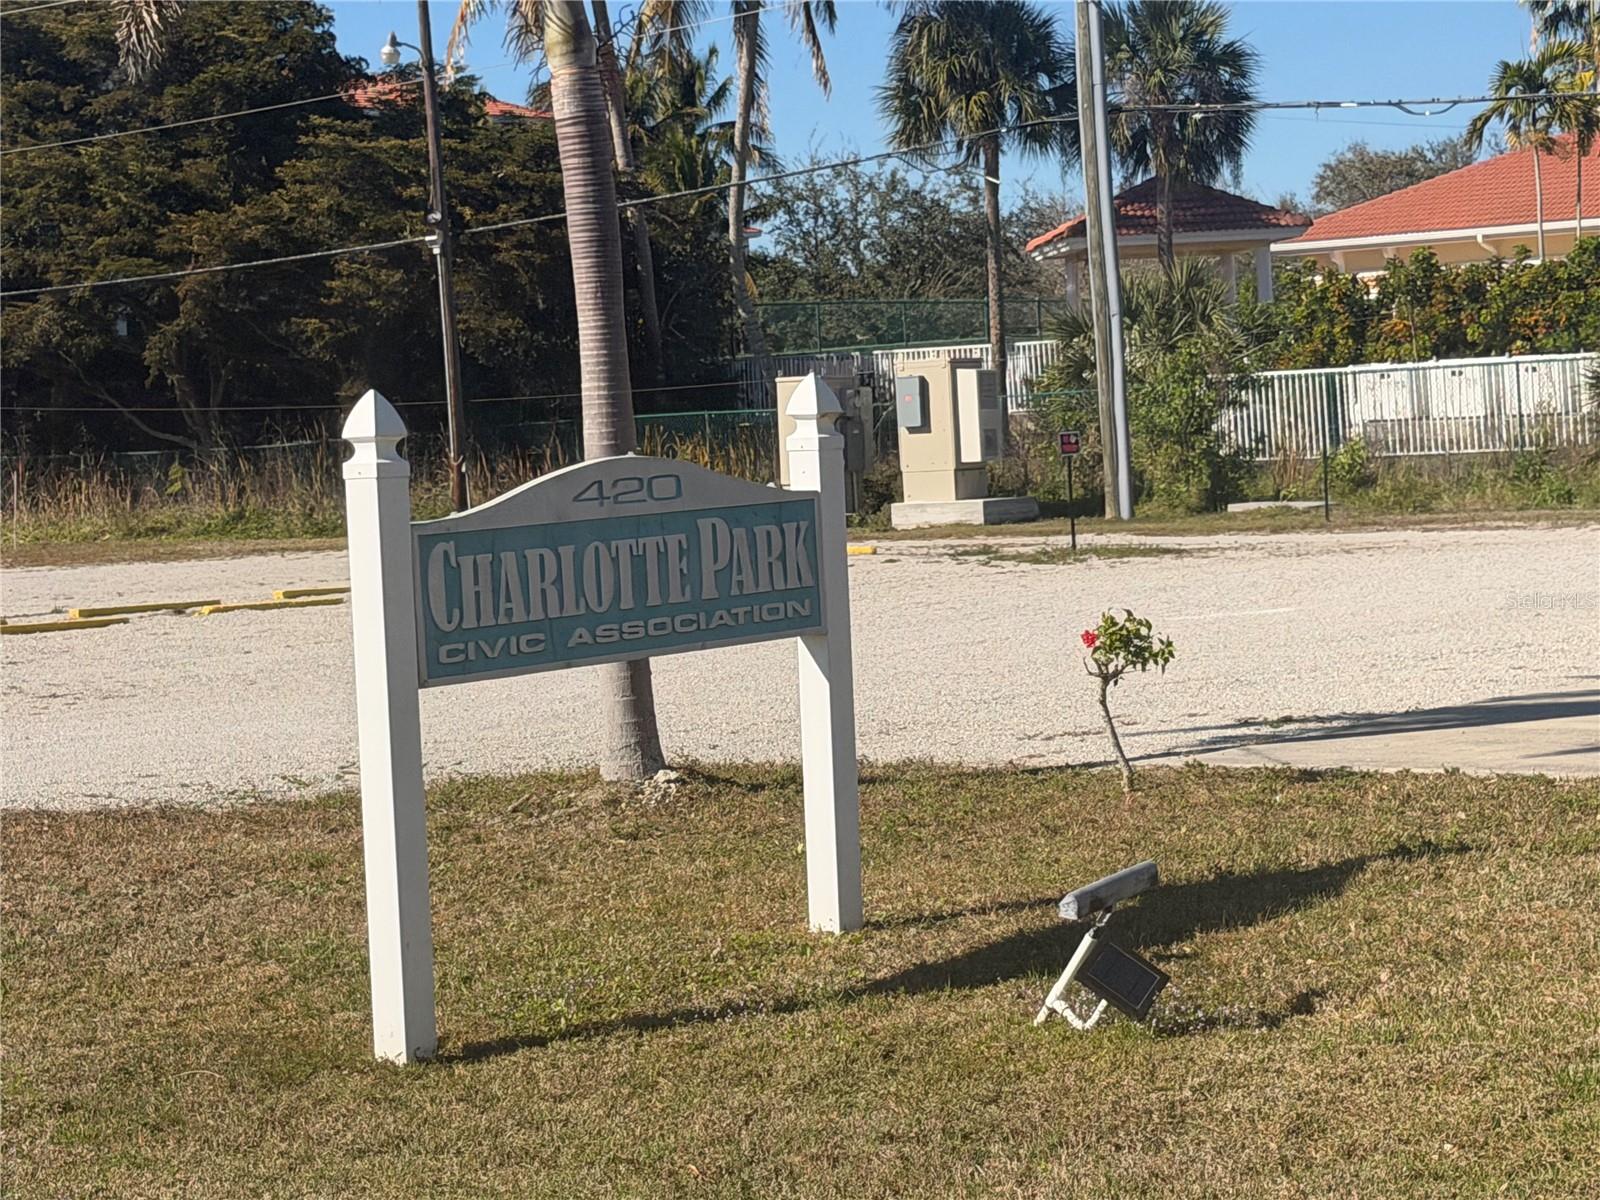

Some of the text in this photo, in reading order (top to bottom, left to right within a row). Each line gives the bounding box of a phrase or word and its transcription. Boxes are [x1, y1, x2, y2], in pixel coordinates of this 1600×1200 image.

[572, 474, 682, 507] 420
[427, 517, 815, 632] CHARLOTTE PARK
[438, 600, 812, 664] CIVIC ASSOCIATION
